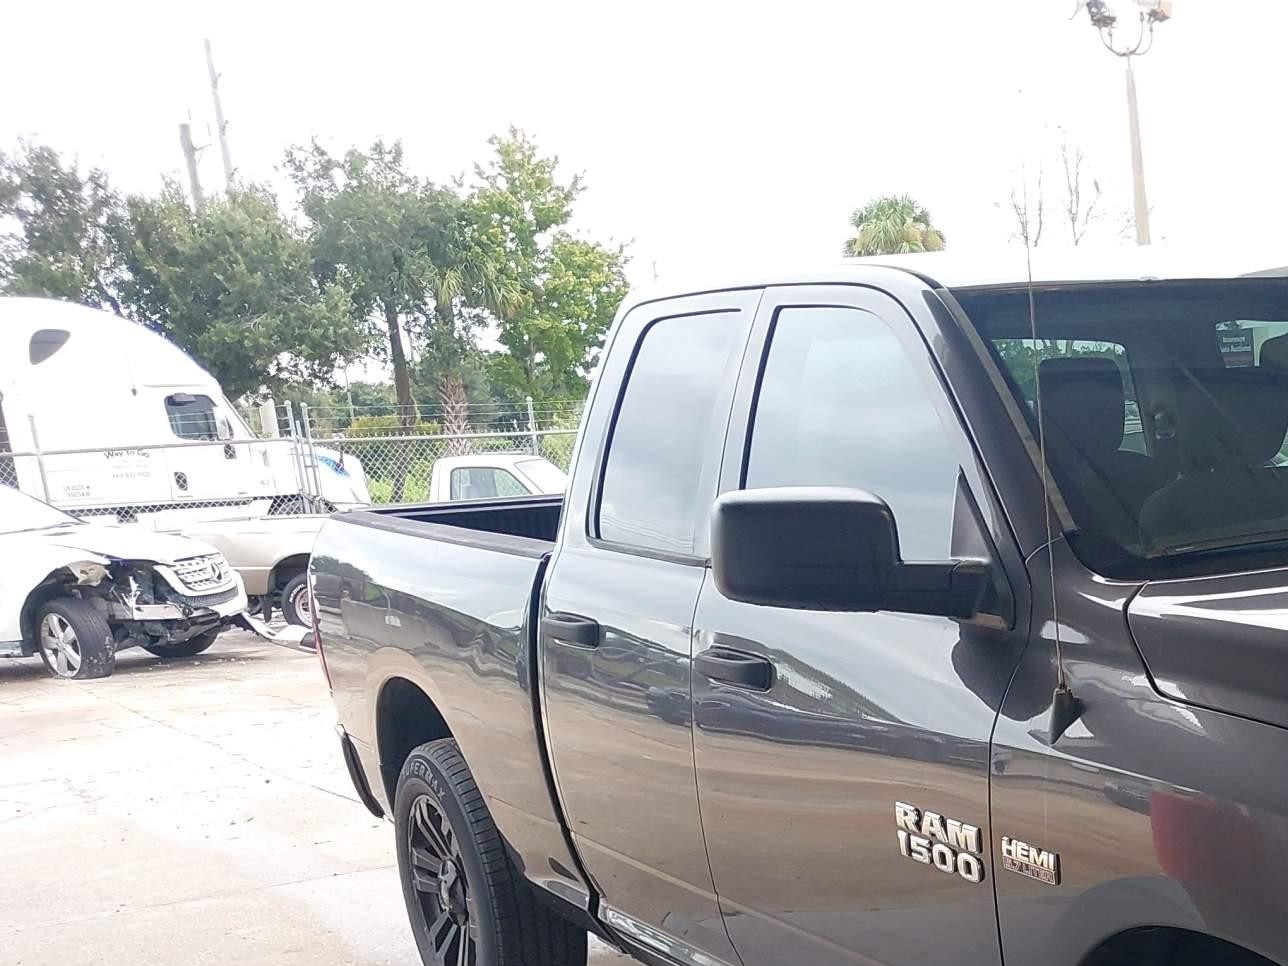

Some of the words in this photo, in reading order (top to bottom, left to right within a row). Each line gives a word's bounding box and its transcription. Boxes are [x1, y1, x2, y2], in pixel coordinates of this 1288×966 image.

[895, 801, 980, 854] RAM
[1001, 836, 1056, 871] HEMI
[896, 829, 982, 883] 1500
